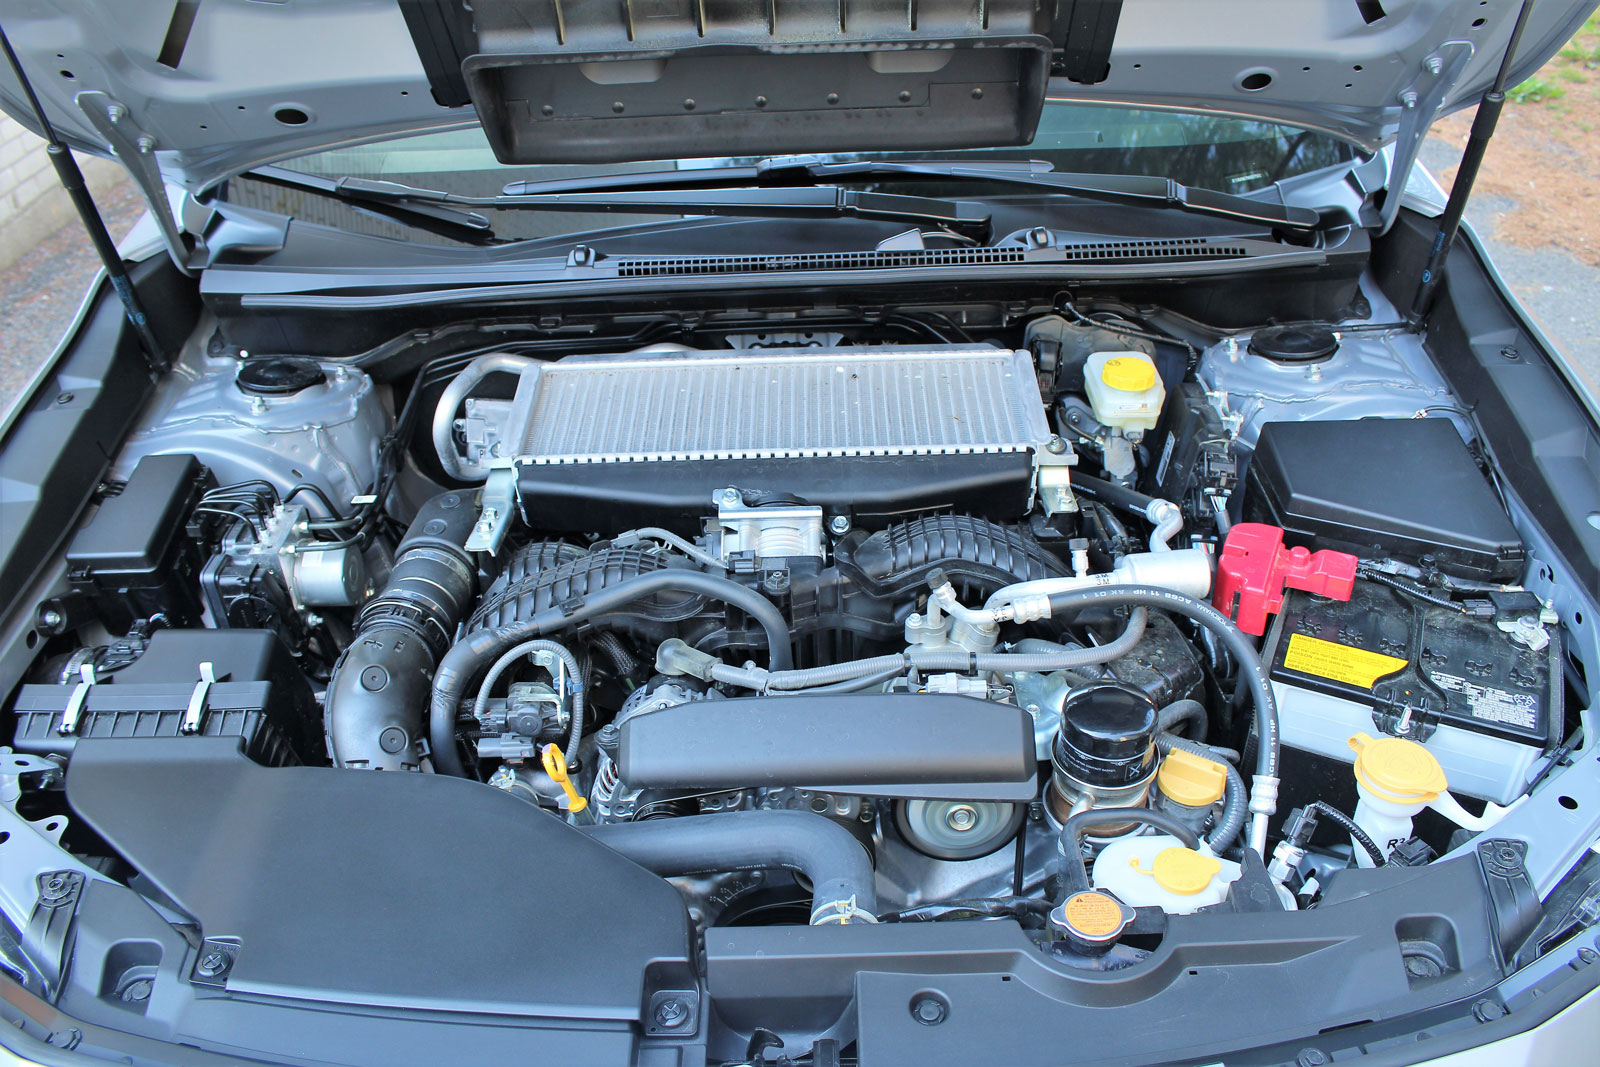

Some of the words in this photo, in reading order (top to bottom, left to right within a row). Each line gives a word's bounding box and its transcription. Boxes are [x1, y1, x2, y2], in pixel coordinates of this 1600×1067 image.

[1196, 603, 1227, 627] YOKOHAMA
[1266, 695, 1273, 709] AK
[1269, 719, 1276, 733] HP
[1270, 737, 1276, 747] 11
